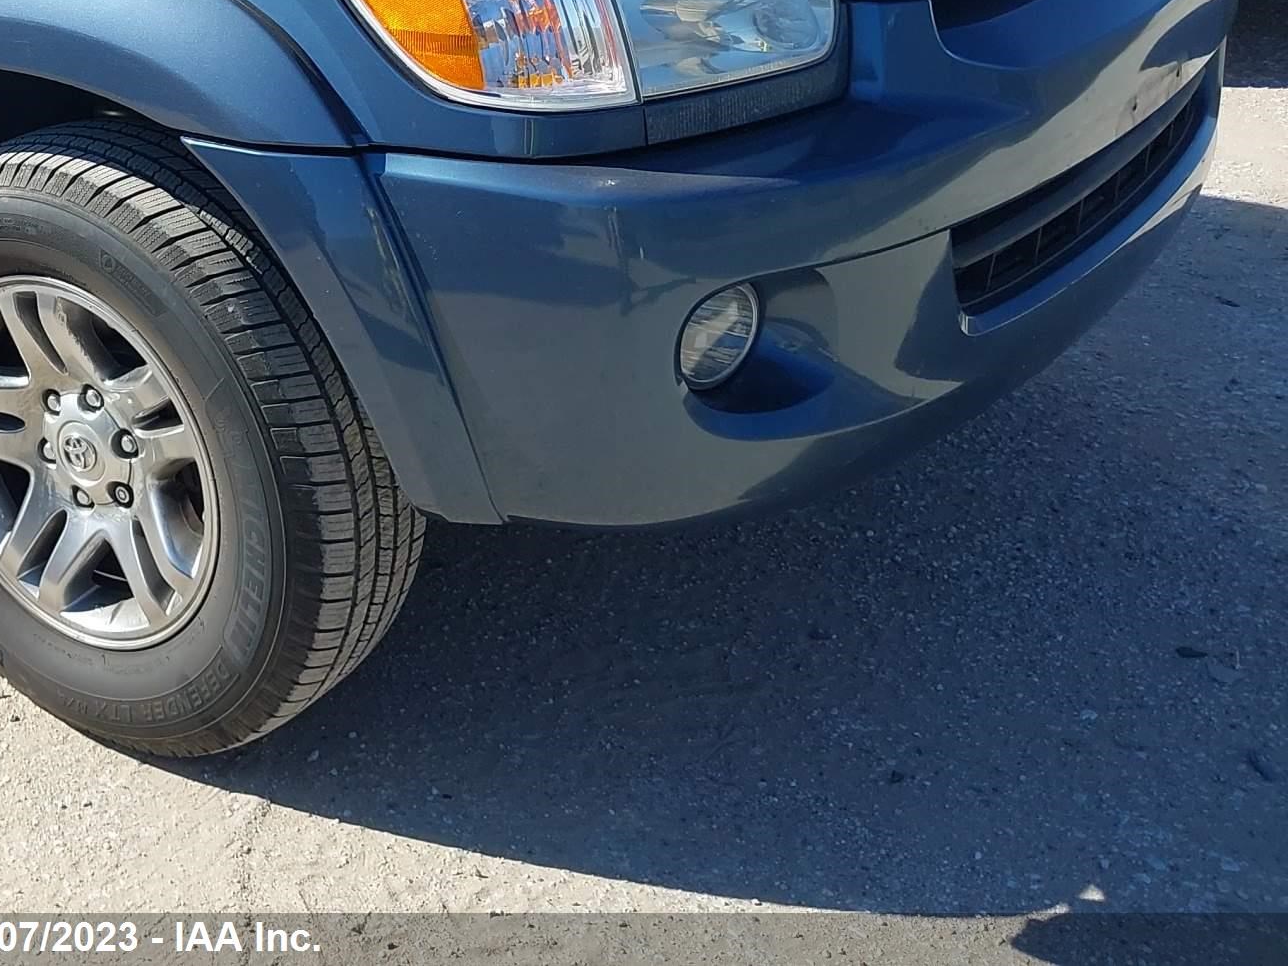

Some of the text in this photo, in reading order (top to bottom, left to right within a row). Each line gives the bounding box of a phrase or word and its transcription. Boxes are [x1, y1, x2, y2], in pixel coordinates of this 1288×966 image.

[224, 460, 269, 664] MICHELIN
[93, 699, 133, 723] LTX
[143, 657, 231, 722] DEFENDER
